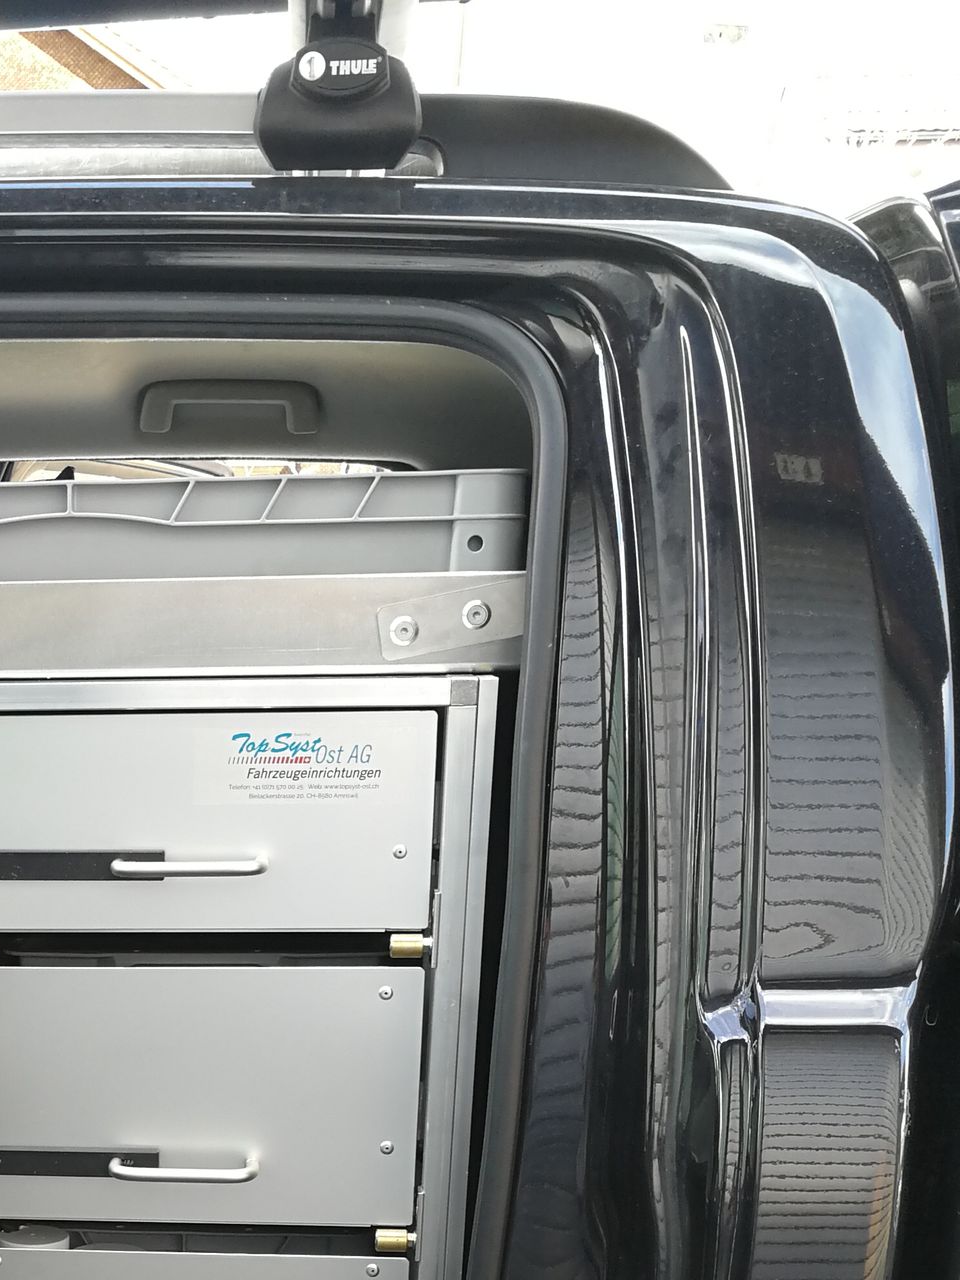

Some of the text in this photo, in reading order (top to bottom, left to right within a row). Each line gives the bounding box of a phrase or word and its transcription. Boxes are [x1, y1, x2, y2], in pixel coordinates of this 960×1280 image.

[329, 58, 377, 75] THULE
[314, 744, 373, 764] Ost AG
[246, 767, 382, 781] Fahrzeugeinrichtungen
